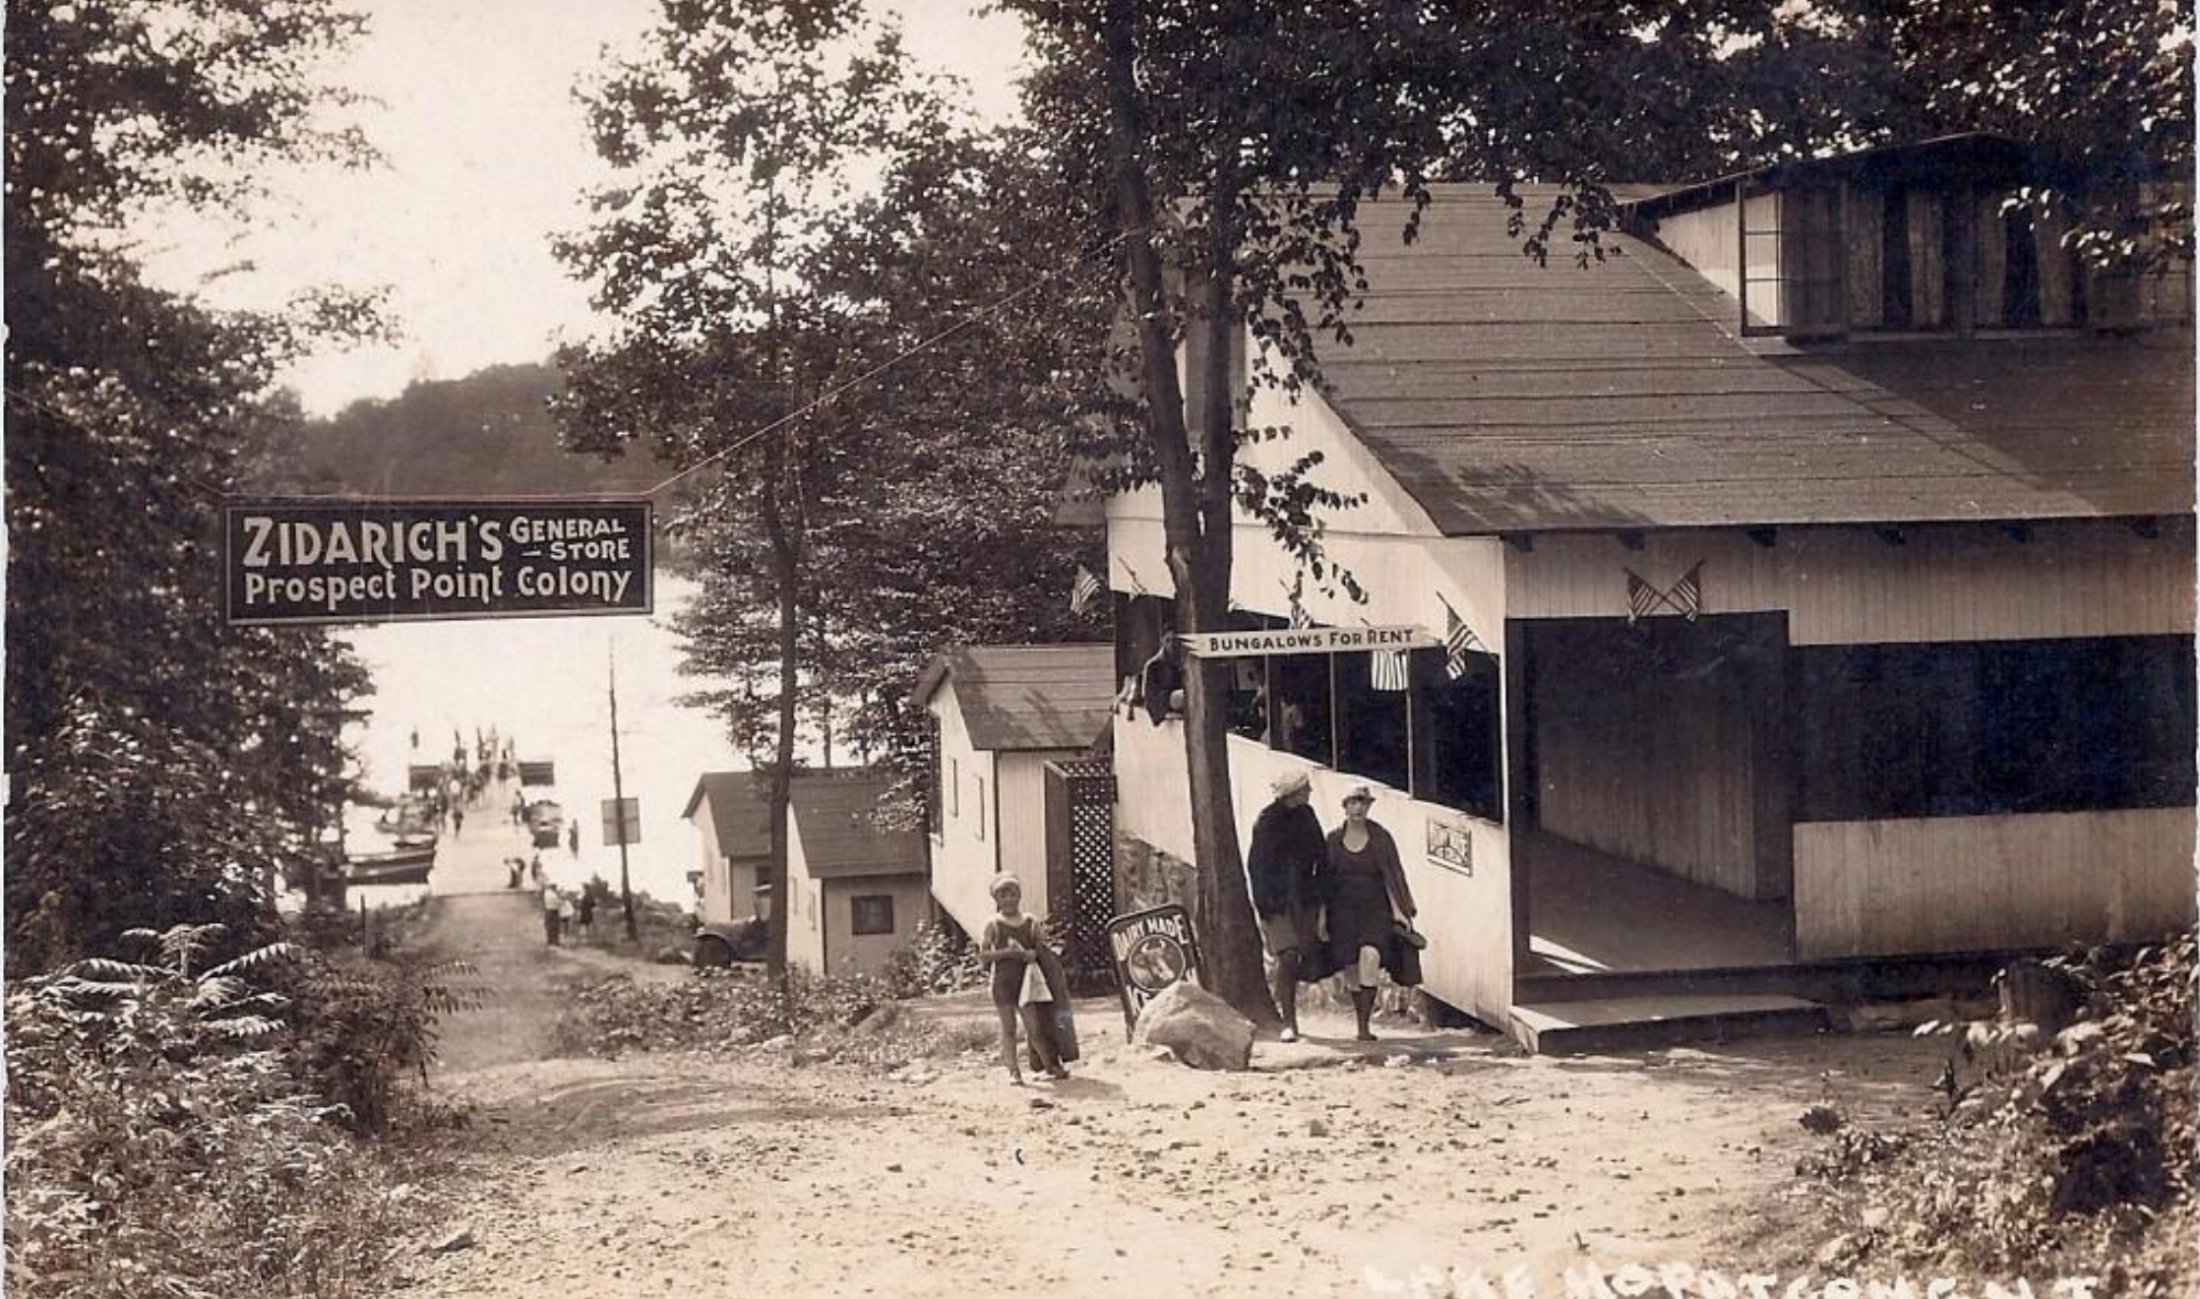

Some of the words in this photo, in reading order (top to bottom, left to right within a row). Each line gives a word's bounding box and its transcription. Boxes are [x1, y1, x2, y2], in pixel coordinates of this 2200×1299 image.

[243, 513, 502, 568] ZIDARICH'S
[509, 515, 626, 544] GENERAL
[549, 538, 631, 561] STORE
[245, 569, 397, 610] Prospect
[411, 566, 502, 604] Point
[517, 565, 632, 602] Colony
[1209, 631, 1323, 652] BUNGALOWS
[1329, 631, 1362, 647] FOR
[1367, 628, 1415, 645] RENT
[1145, 914, 1191, 944] MADE
